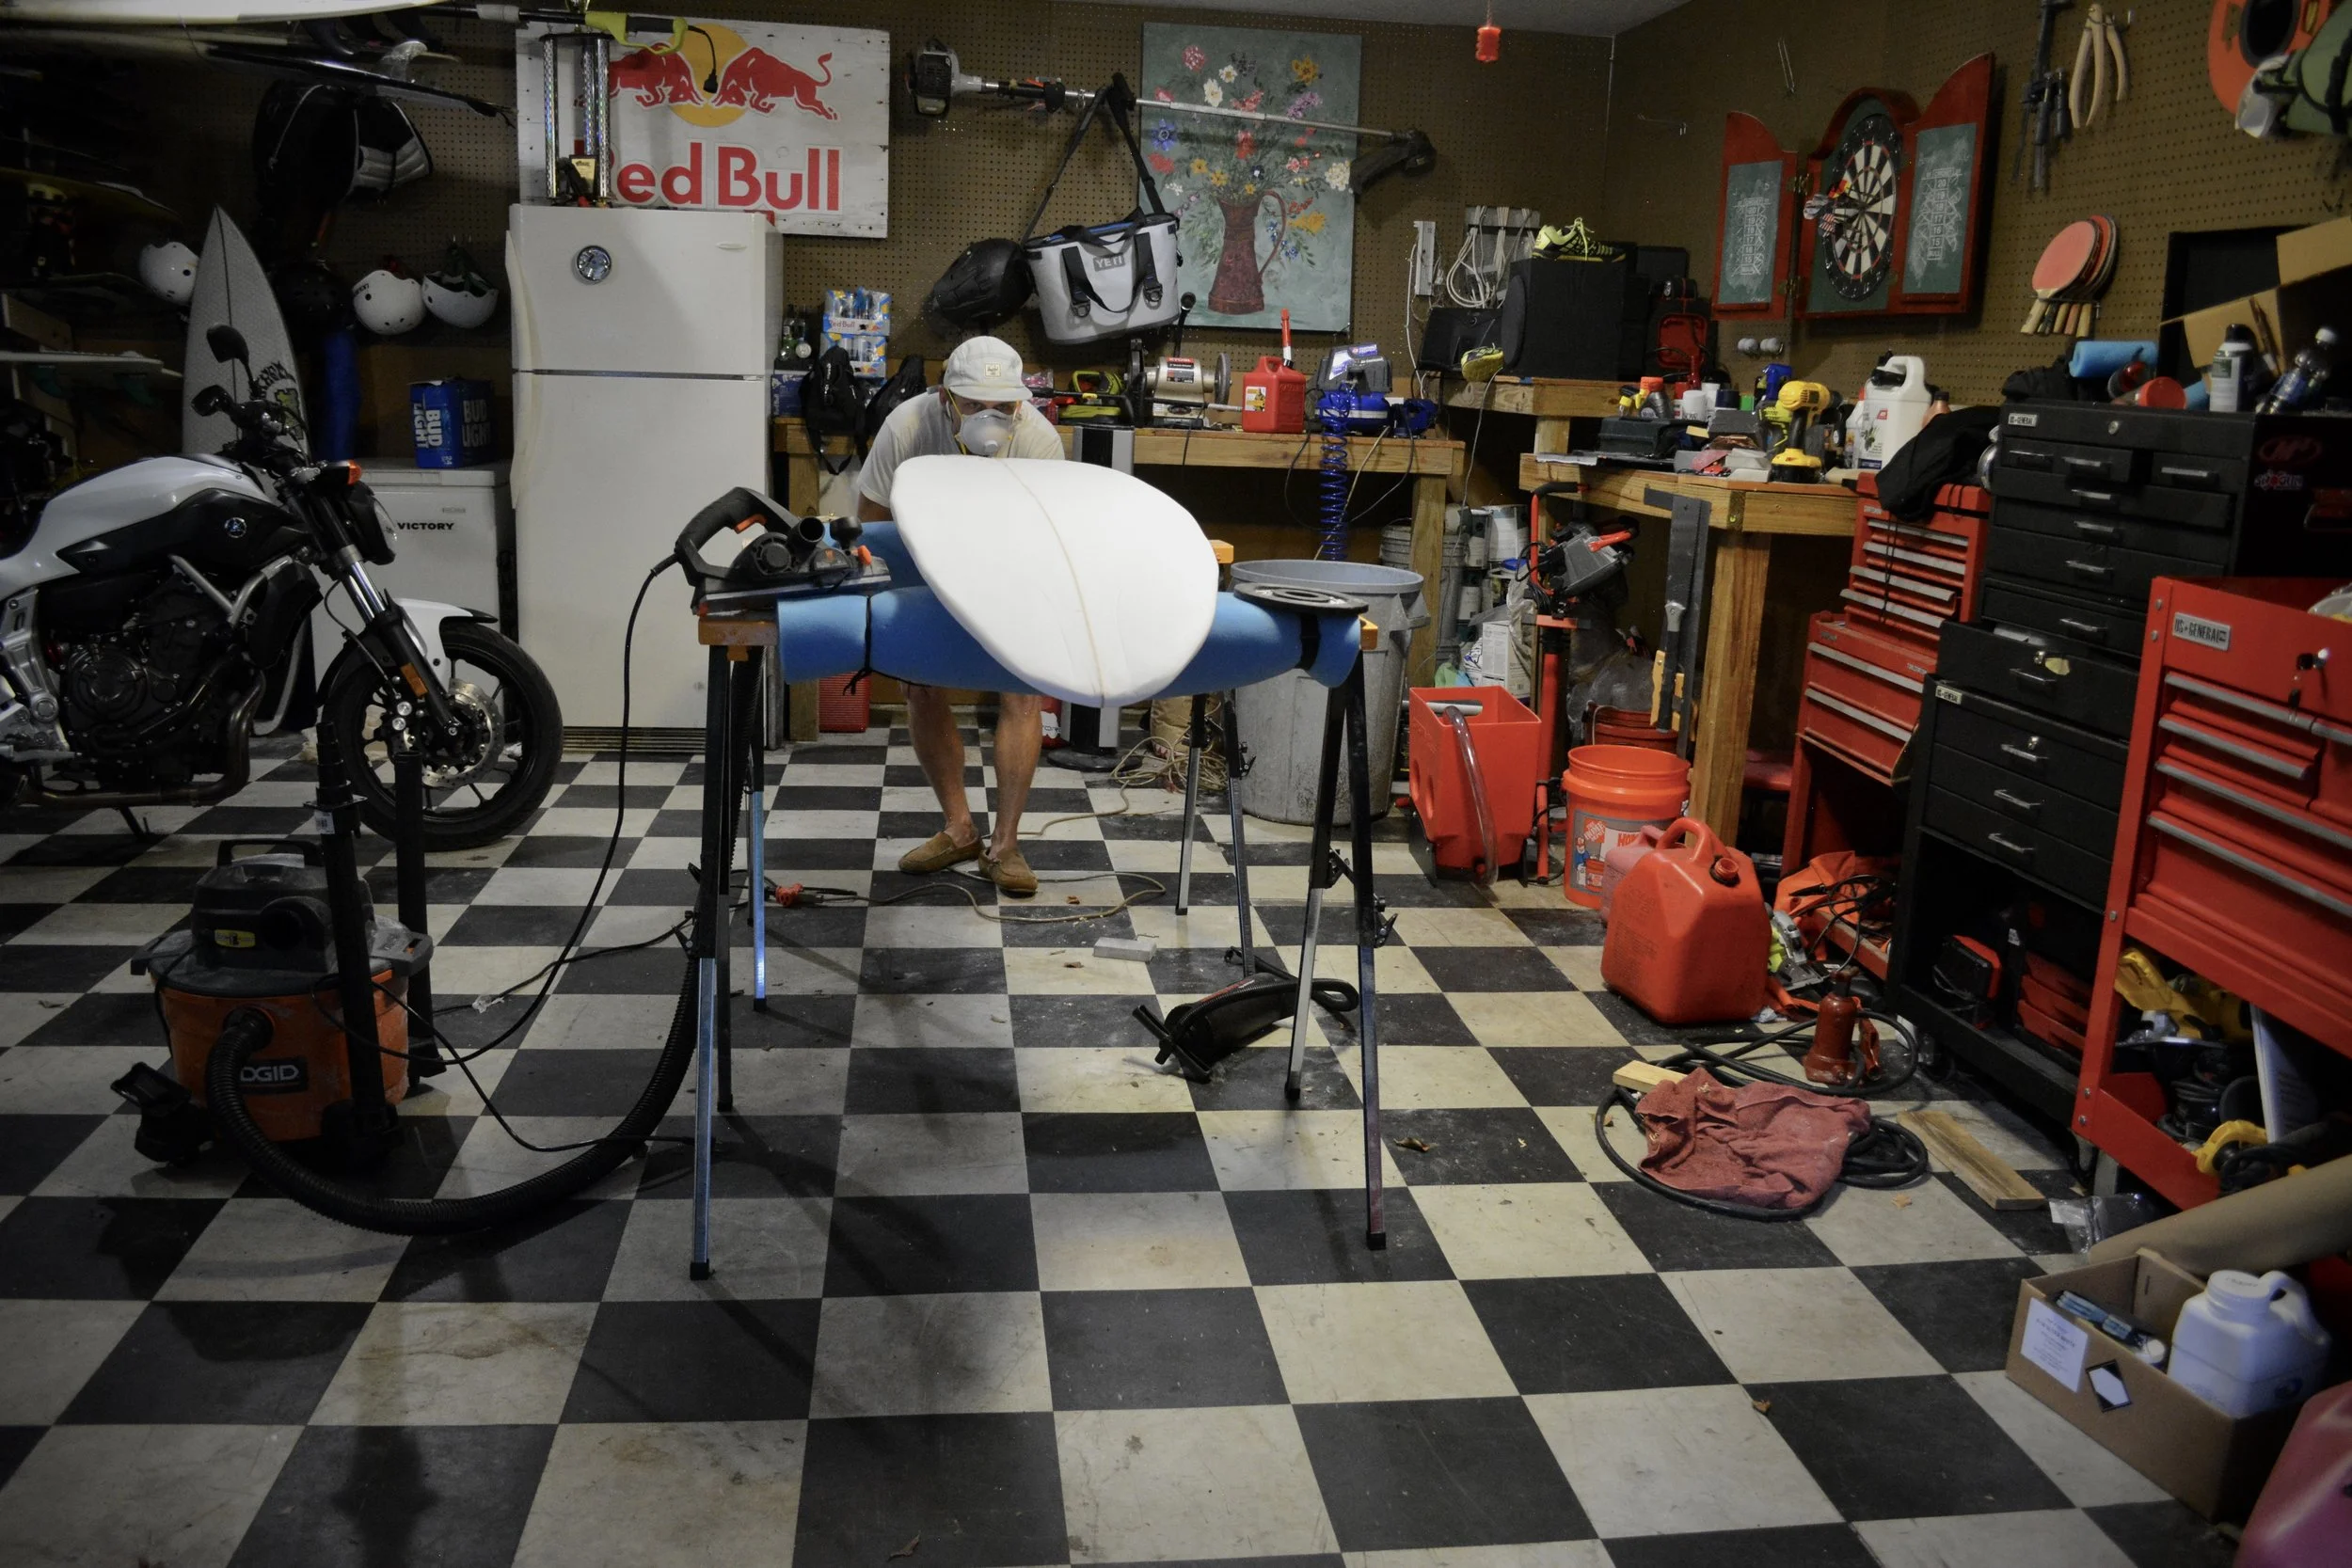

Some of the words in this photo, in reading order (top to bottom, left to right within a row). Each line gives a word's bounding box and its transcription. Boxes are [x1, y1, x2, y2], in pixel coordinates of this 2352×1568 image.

[574, 139, 702, 205] ed
[718, 146, 839, 211] Bull
[1095, 255, 1123, 268] YETI
[463, 399, 488, 422] BUD
[414, 403, 429, 448] LIGHT
[426, 410, 443, 446] BUD
[397, 522, 454, 531] VICTORY
[2174, 618, 2184, 633] US
[2188, 622, 2220, 643] GENERAL
[239, 1064, 300, 1083] DGID
